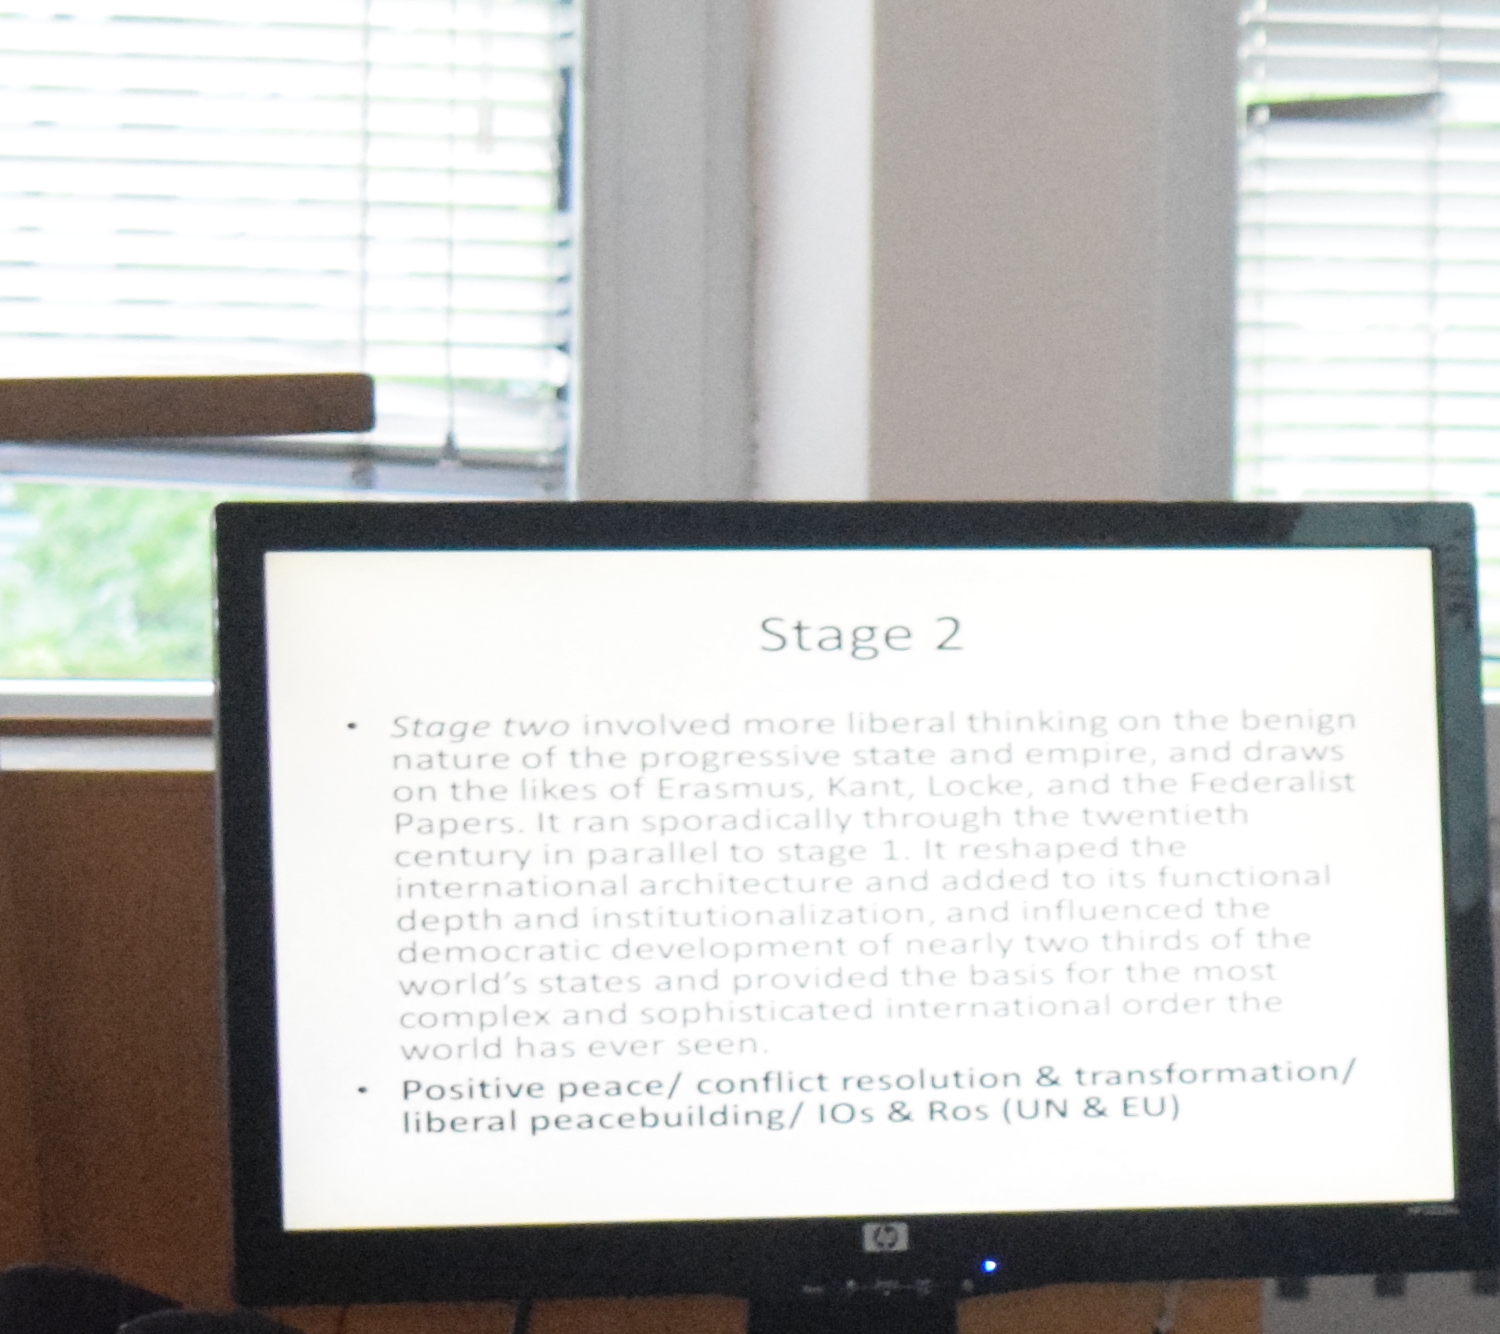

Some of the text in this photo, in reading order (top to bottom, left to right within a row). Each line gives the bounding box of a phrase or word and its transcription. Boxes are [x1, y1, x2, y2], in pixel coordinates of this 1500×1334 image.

[760, 615, 964, 661] Stage 2
[390, 709, 1356, 744] Stage two involved more liberal thinking on the benign
[392, 740, 1344, 773] nature of the progressive state and empire, and draws
[392, 770, 1355, 803] on the likes of Erasmus, Kant, Locke, and the Federalist
[395, 803, 1248, 840] Papers. It ran sporadically through the twentieth
[394, 836, 1186, 871] century in parallel to stage 1. It reshaped the
[396, 864, 1330, 899] international architecture and added to its functional
[396, 897, 1270, 937] depth and institutionalization, and influenced the
[397, 927, 1311, 964] democratic development of nearly two thirds of the
[539, 973, 641, 994] states
[655, 968, 719, 992] and
[733, 966, 888, 995] provided
[900, 965, 956, 987] the
[970, 964, 1054, 986] basis
[1066, 962, 1111, 984] for
[1125, 962, 1180, 983] the
[1194, 962, 1275, 981] most
[399, 991, 1282, 1033] complex and sophisticated international order the
[400, 1036, 767, 1061] world has ever seen.
[402, 1057, 1357, 1104] Positive peace/ conflict resolution & transformation/
[402, 1093, 1180, 1137] liberal peacebuilding/ IOs & Ros (UN & EU)
